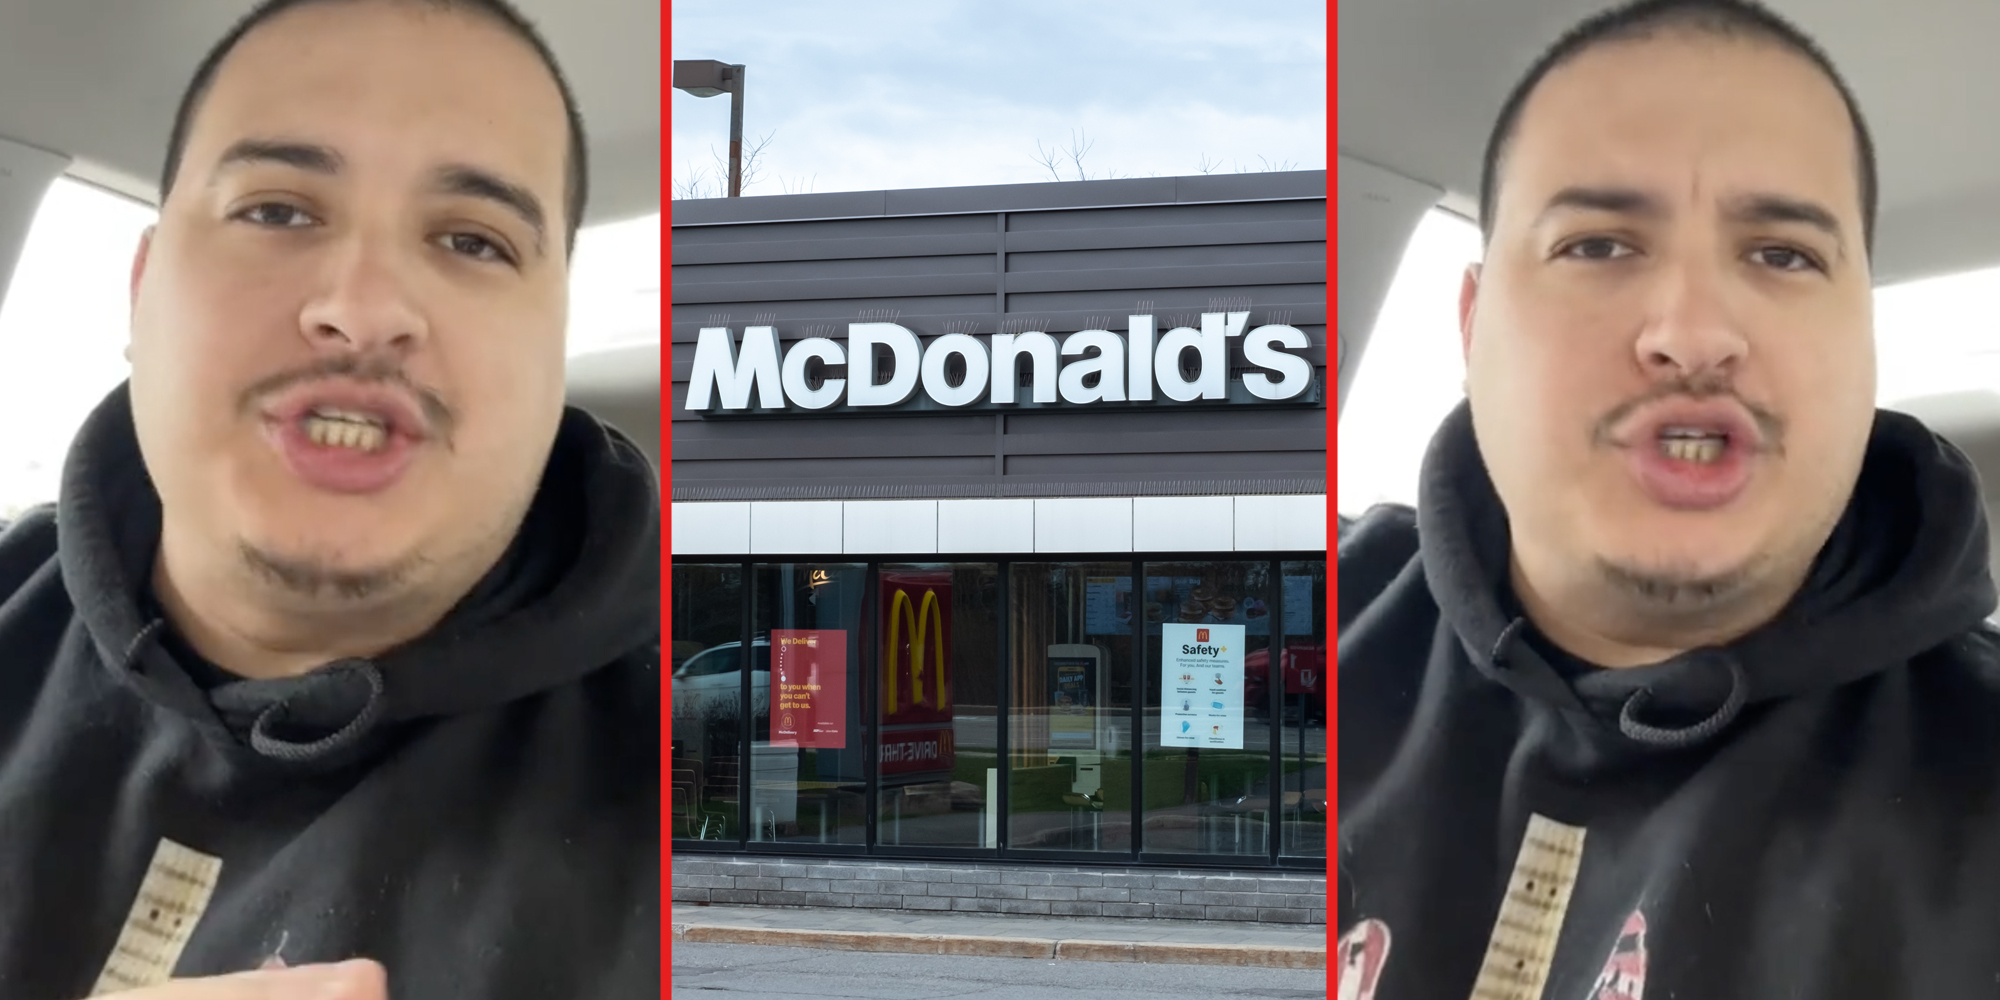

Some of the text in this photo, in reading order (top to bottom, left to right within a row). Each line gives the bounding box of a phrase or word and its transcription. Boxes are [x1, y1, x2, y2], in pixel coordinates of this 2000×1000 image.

[685, 310, 1313, 410] McDonald's
[780, 637, 817, 645] We Deliver
[788, 684, 801, 692] you
[802, 683, 821, 691] when
[780, 692, 810, 701] you can't
[780, 702, 791, 710] get
